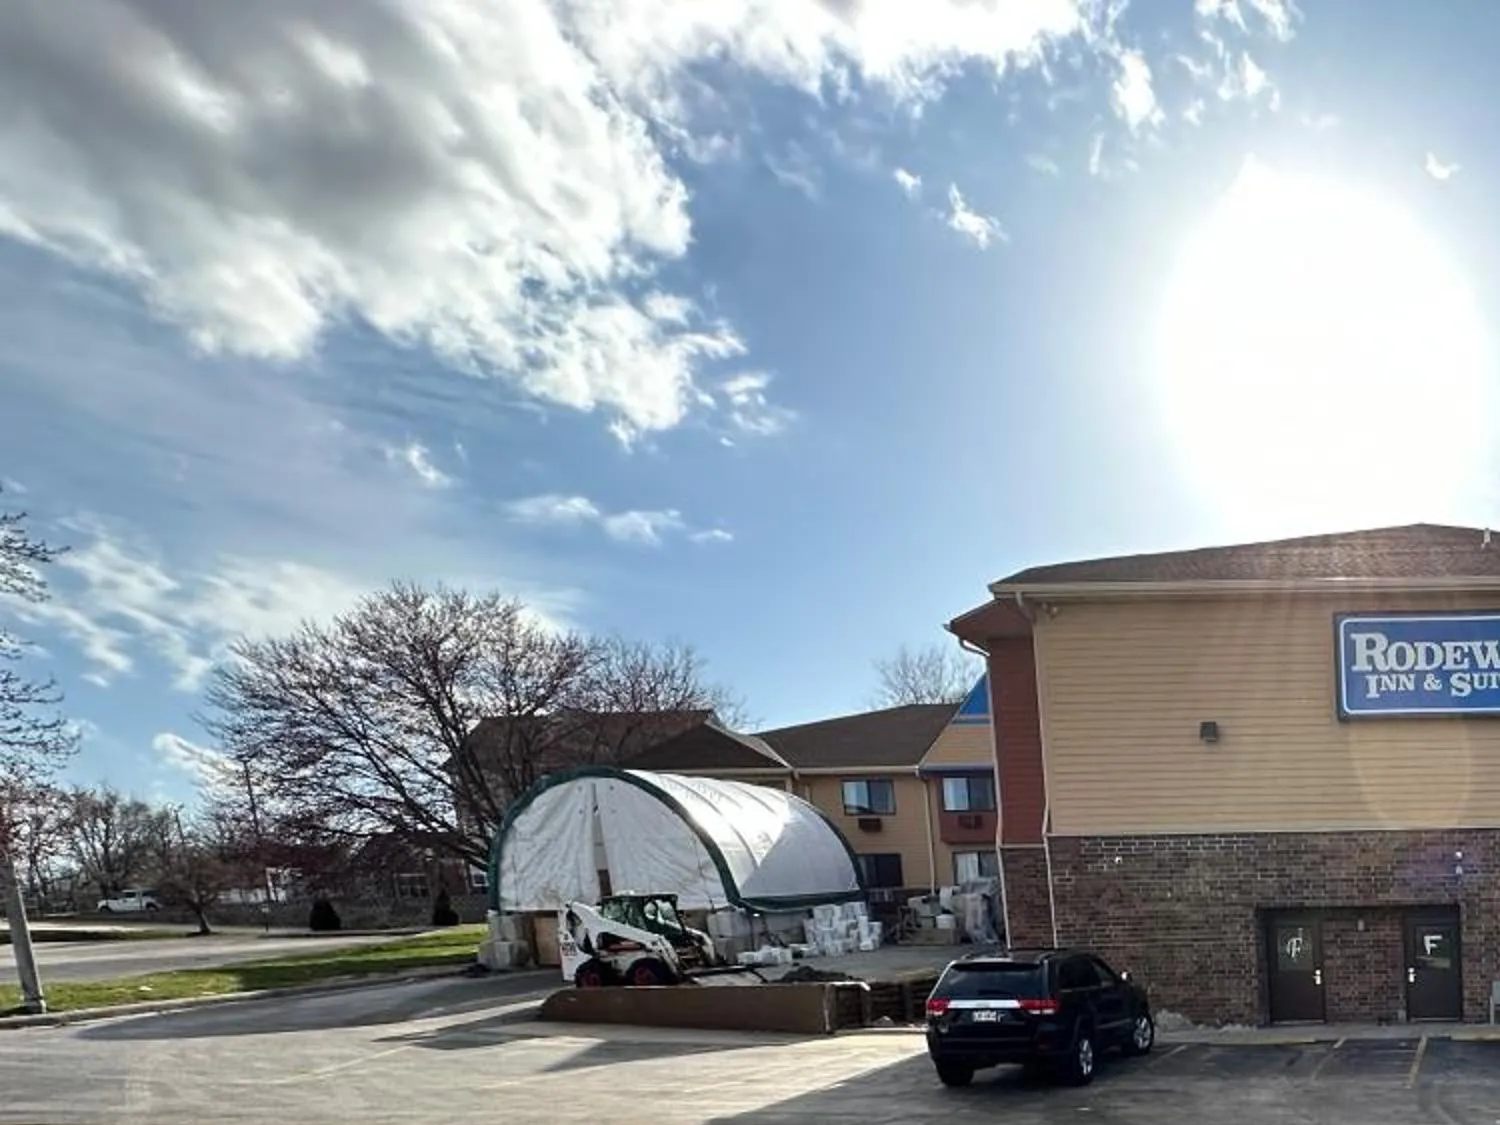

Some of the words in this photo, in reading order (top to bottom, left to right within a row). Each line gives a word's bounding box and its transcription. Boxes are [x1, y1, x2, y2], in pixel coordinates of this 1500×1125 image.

[1365, 674, 1416, 699] INN
[1423, 673, 1443, 691] &
[1423, 935, 1443, 955] F
